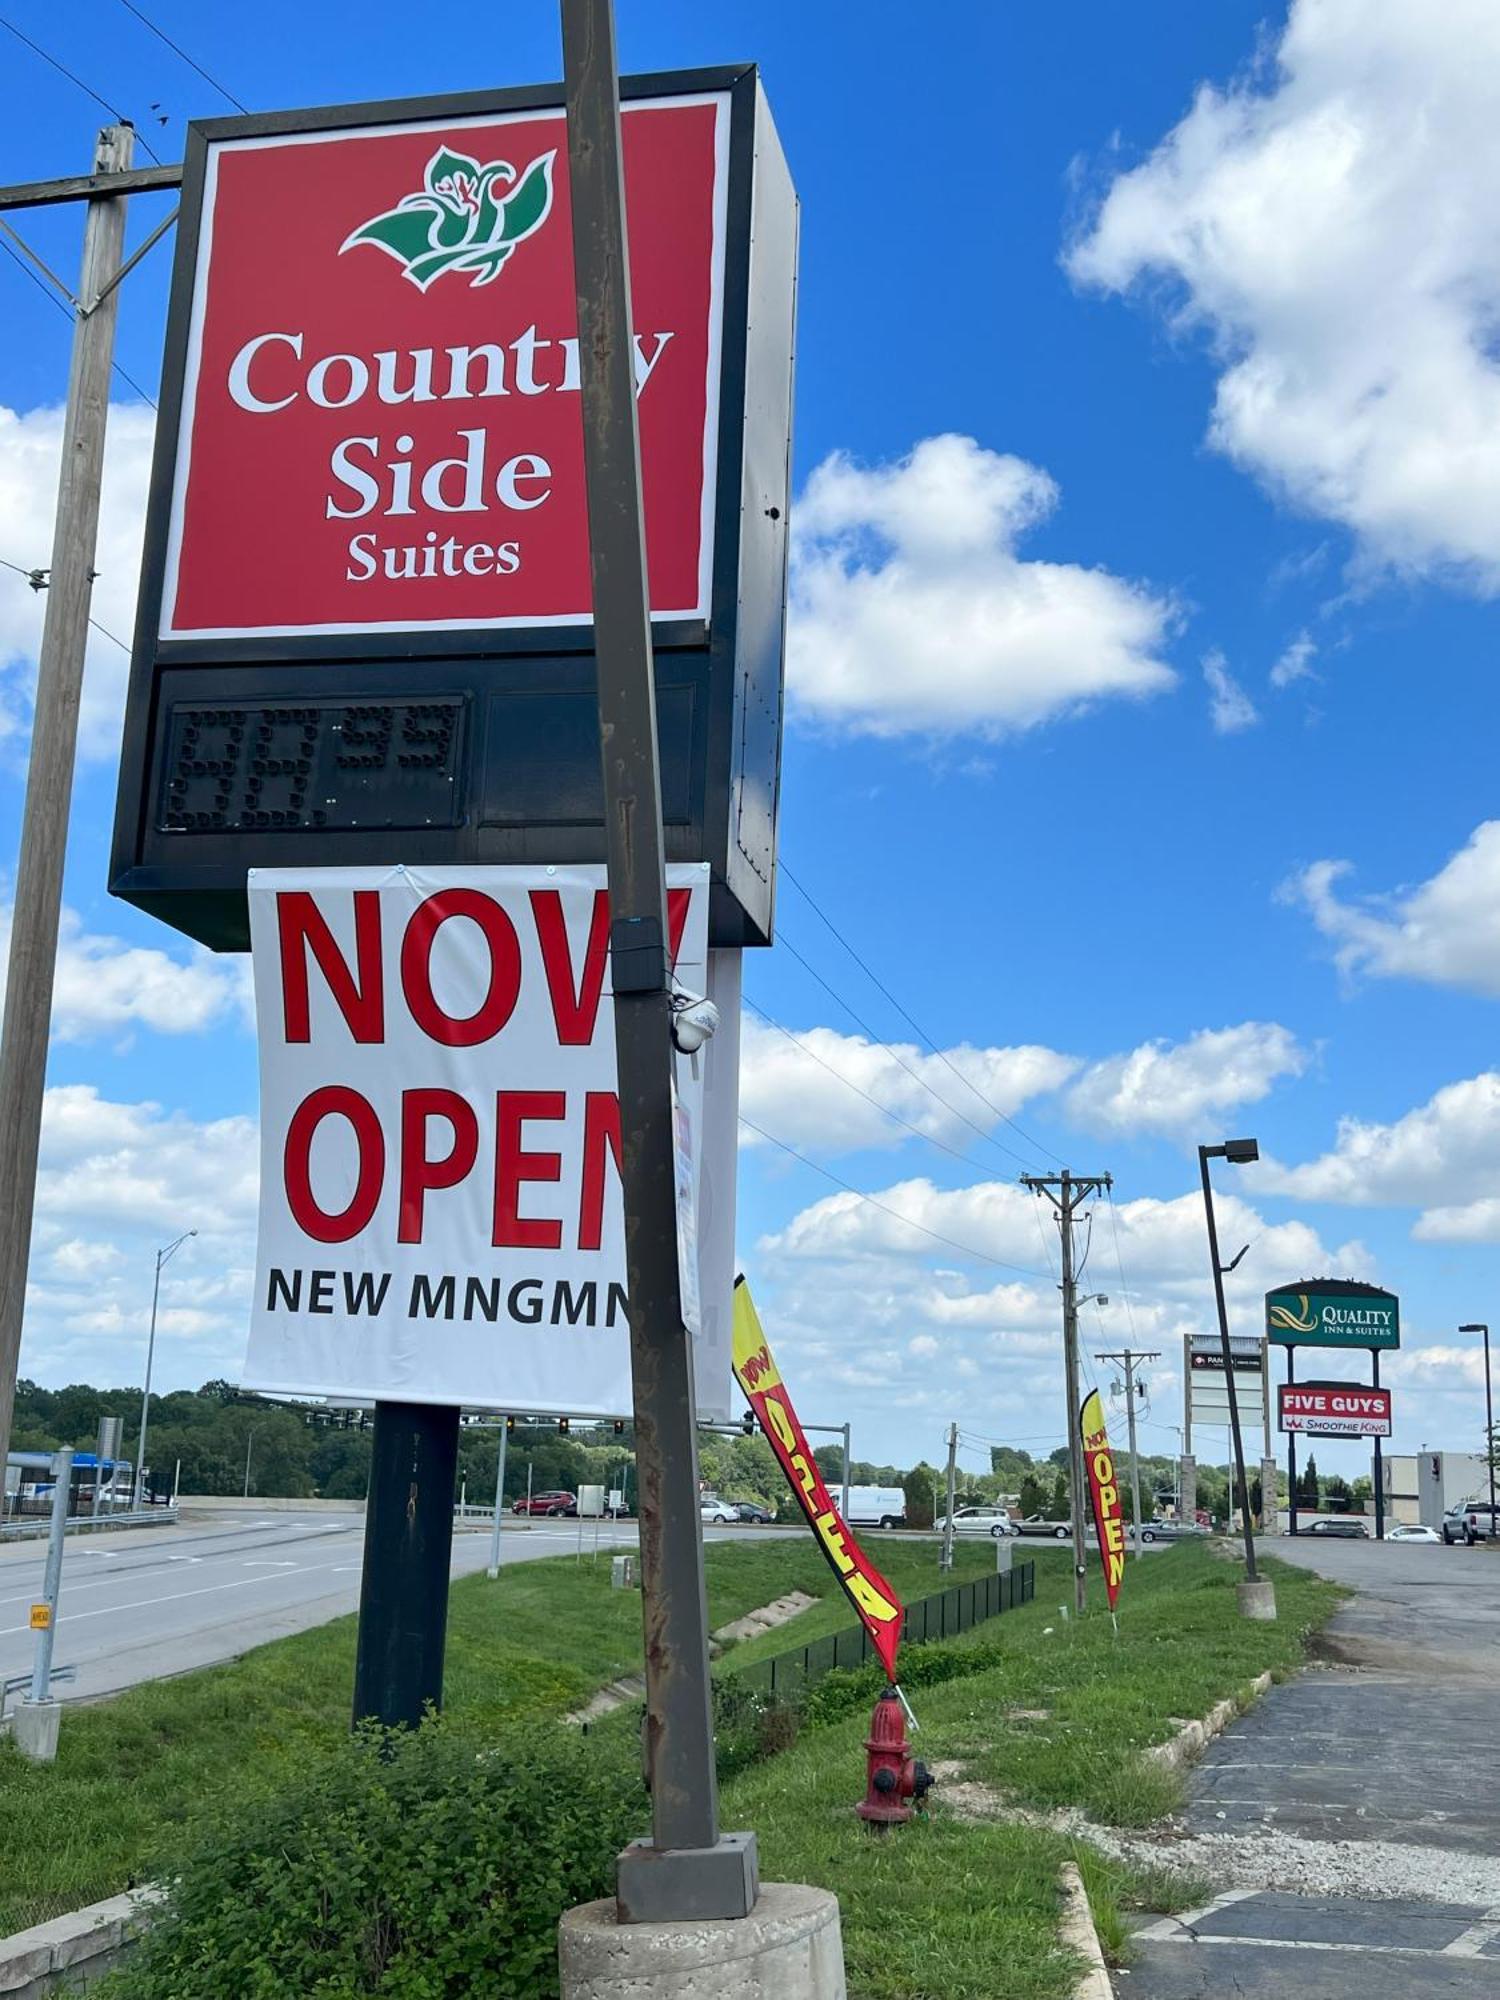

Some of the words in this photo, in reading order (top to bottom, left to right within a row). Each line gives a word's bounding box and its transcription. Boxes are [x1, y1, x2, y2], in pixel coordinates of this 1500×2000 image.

[326, 428, 552, 519] Side
[346, 531, 521, 581] Suites
[276, 887, 692, 1047] NOW
[267, 1268, 391, 1316] NEW
[407, 1274, 630, 1327] MNGMN
[1322, 1306, 1392, 1325] QUALITY
[1324, 1326, 1344, 1334] INN
[1355, 1327, 1391, 1335] SUITES
[1284, 1395, 1326, 1410] FIVE
[1331, 1397, 1385, 1413] GUYS
[1093, 1452, 1124, 1586] OPEN
